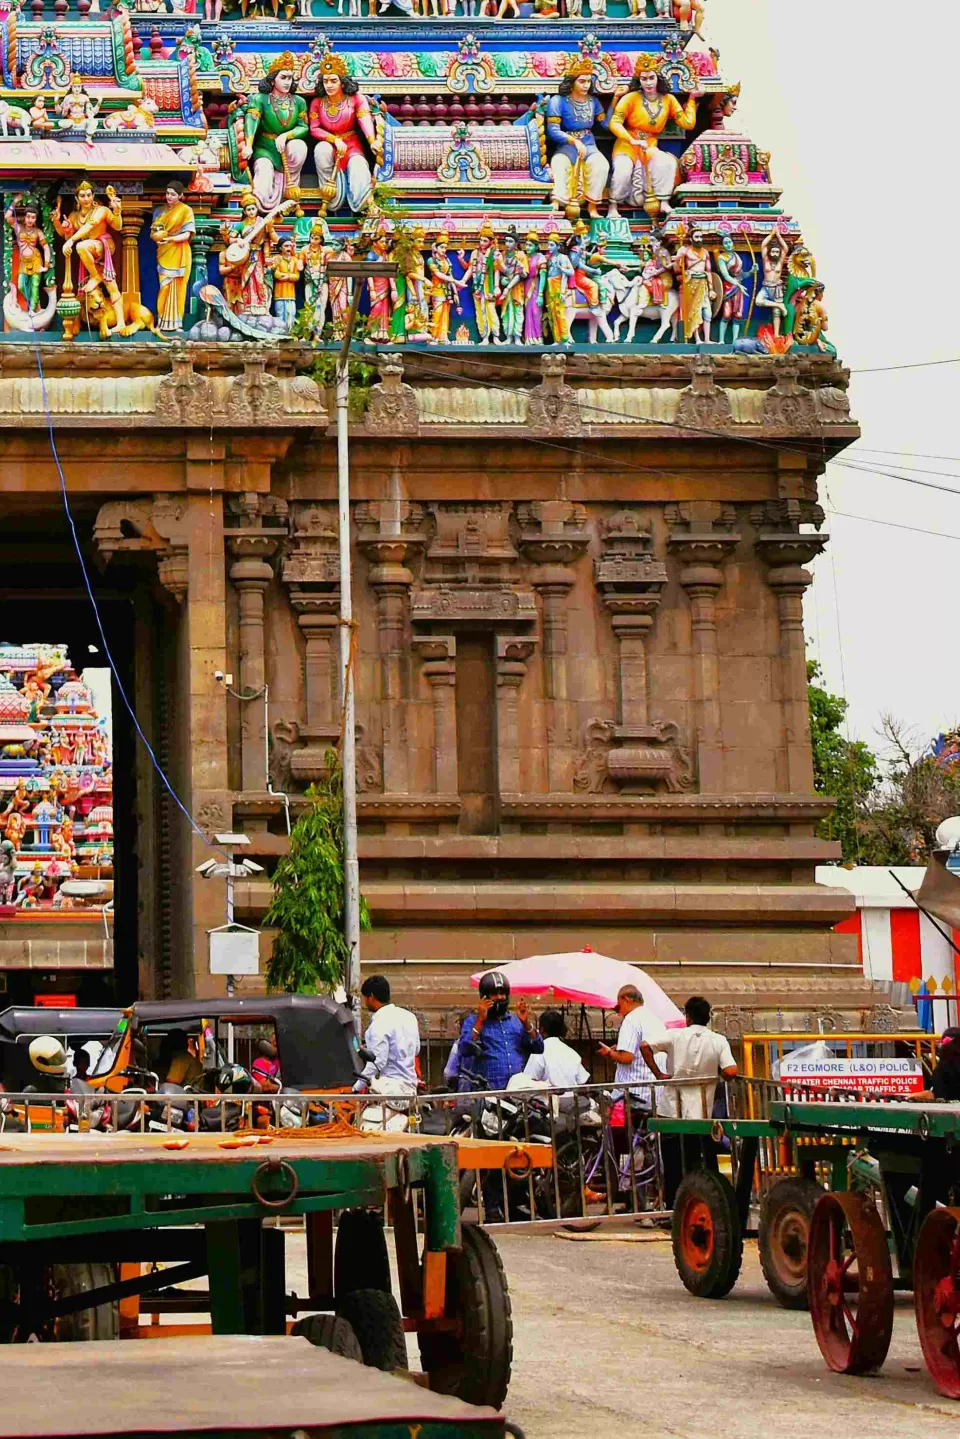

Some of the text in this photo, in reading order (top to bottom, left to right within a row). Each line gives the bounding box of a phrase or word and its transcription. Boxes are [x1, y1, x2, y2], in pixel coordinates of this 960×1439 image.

[787, 1063, 916, 1073] F2 EGMORE (L&O) POLIC
[857, 1077, 889, 1085] TRAFFIC
[890, 1077, 918, 1085] POLICE
